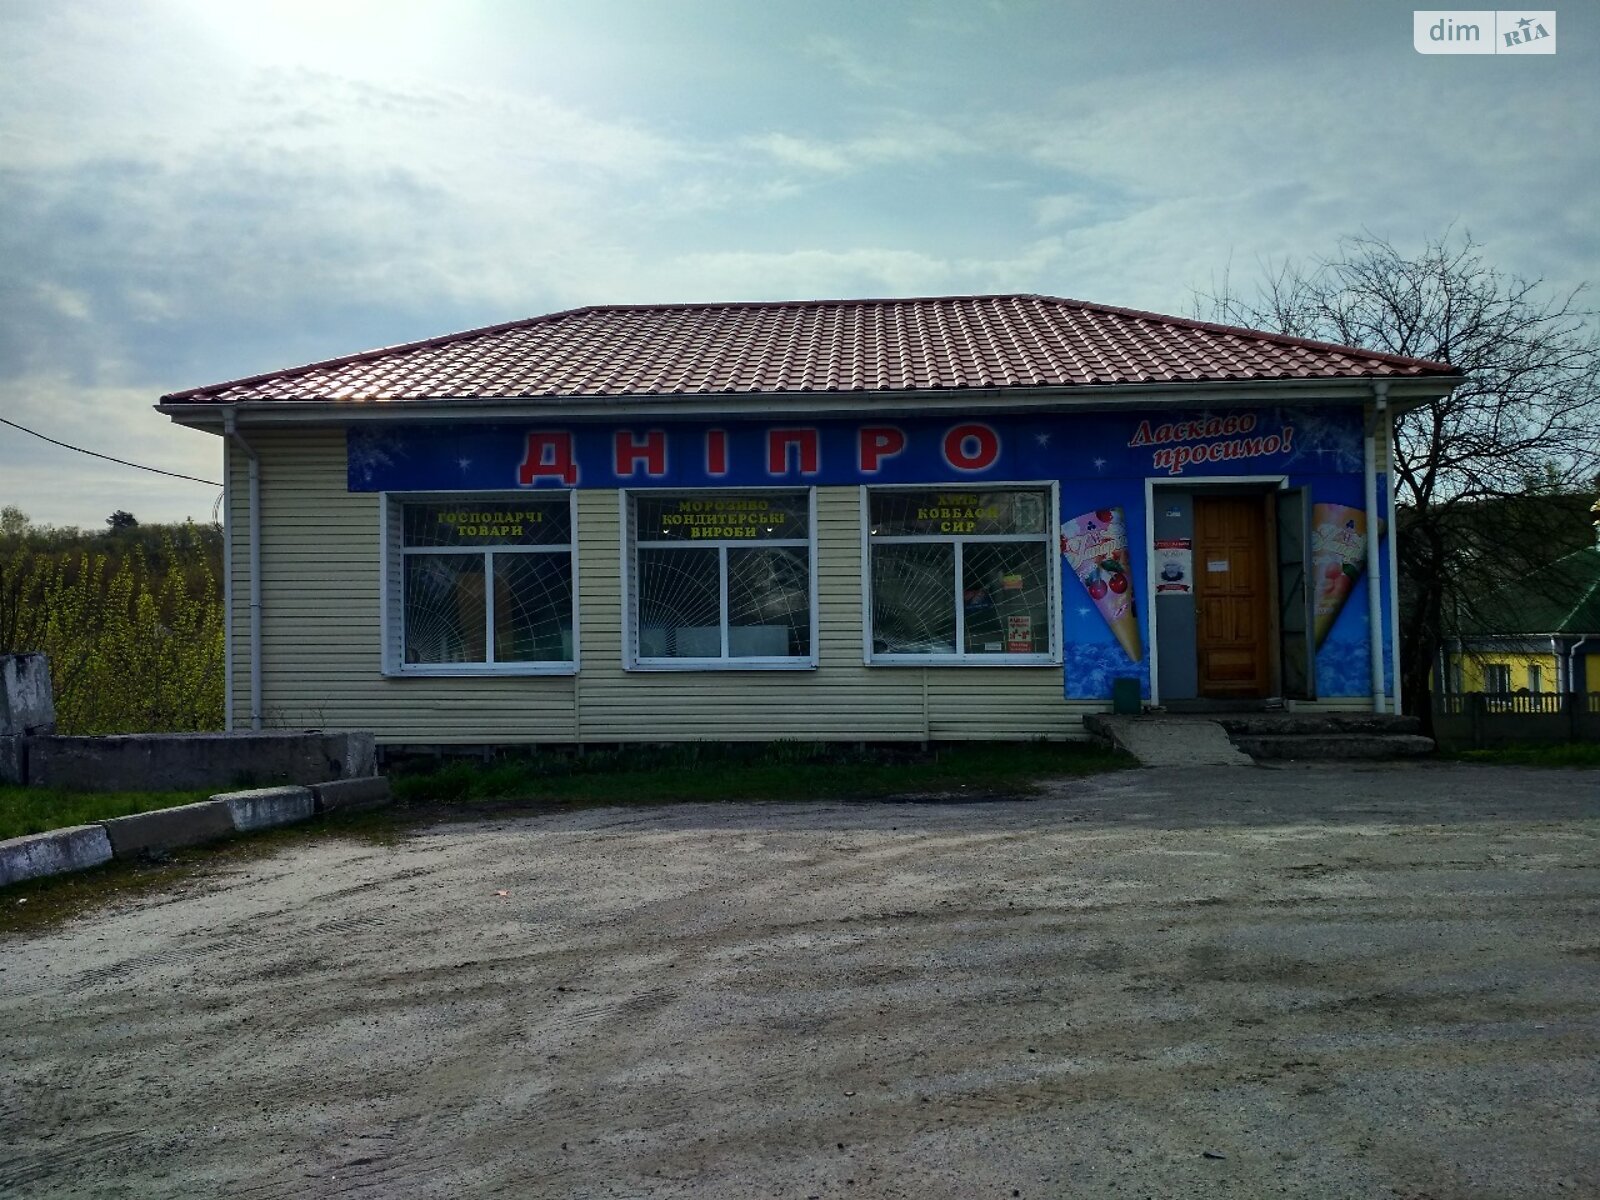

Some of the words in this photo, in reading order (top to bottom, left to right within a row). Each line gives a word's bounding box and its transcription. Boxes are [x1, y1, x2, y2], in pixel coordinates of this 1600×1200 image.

[1128, 414, 1257, 448] Ласкаво
[518, 424, 1000, 486] ДНІПРО
[1153, 426, 1294, 475] просимо!
[679, 500, 769, 511] МОРОЗИВО
[438, 511, 543, 523] ГОСПОДАРЧІ
[662, 513, 785, 525] КОНДИТЕРСЬКІ
[456, 525, 524, 536] ТОВАРИ
[690, 526, 757, 538] ВИРОБИ
[940, 521, 976, 532] СИР
